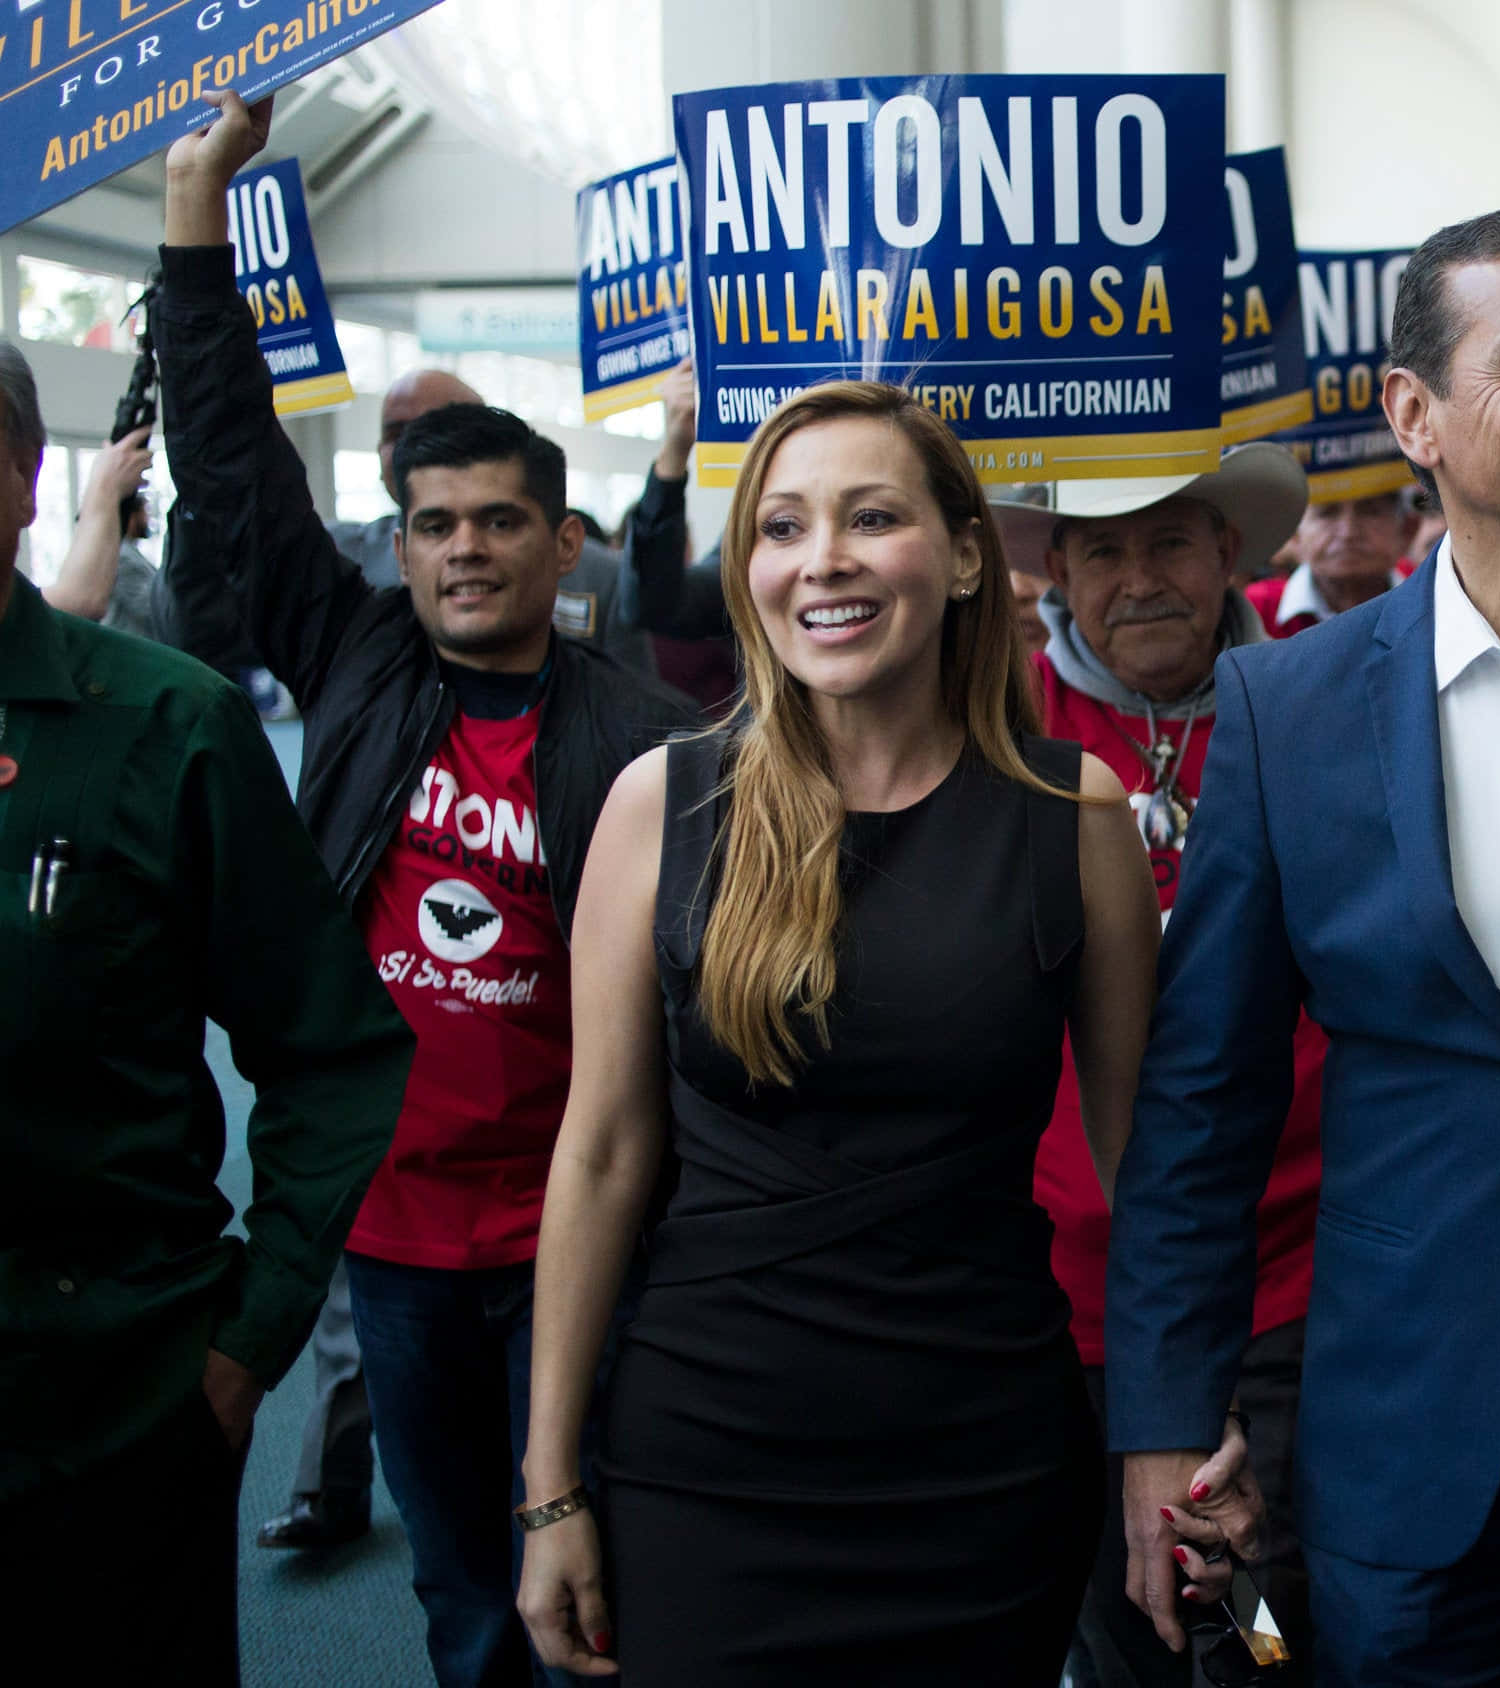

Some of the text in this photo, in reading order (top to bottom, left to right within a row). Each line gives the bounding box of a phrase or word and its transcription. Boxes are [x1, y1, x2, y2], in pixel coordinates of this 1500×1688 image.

[40, 0, 381, 182] AntonioForCalifo
[59, 35, 162, 107] FOR
[704, 94, 1167, 255] ANTONIO
[708, 265, 1173, 344] VILLARAIGOSA
[716, 385, 776, 424] GIVING
[984, 377, 1171, 420] CALIFORNIAN
